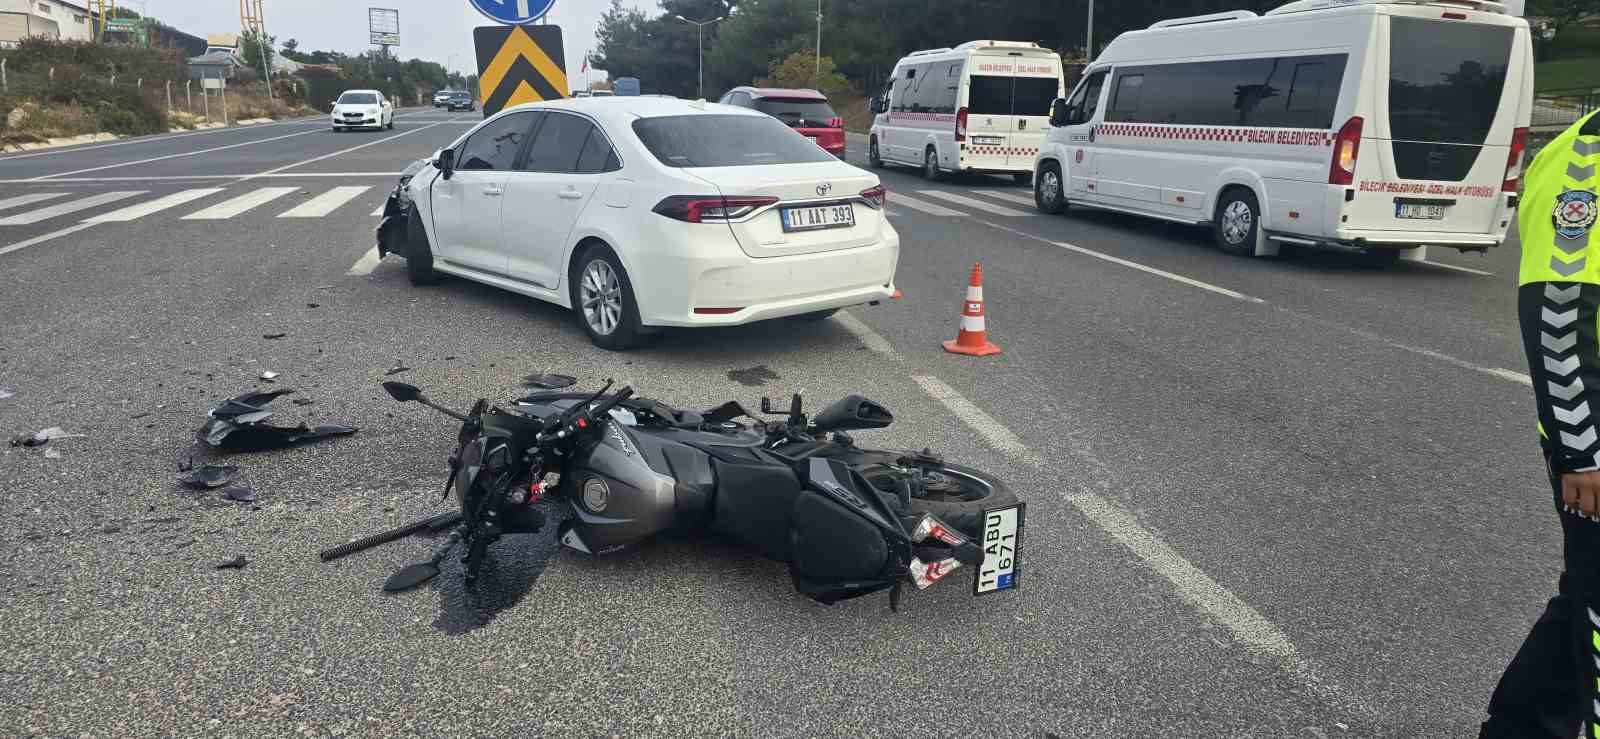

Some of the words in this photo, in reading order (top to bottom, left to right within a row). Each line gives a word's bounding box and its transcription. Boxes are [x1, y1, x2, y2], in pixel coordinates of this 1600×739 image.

[791, 210, 803, 225] 11
[808, 208, 827, 225] AAT
[832, 207, 851, 222] 393
[985, 514, 1001, 555] ABU
[998, 534, 1014, 570] 671
[981, 569, 995, 587] 11
